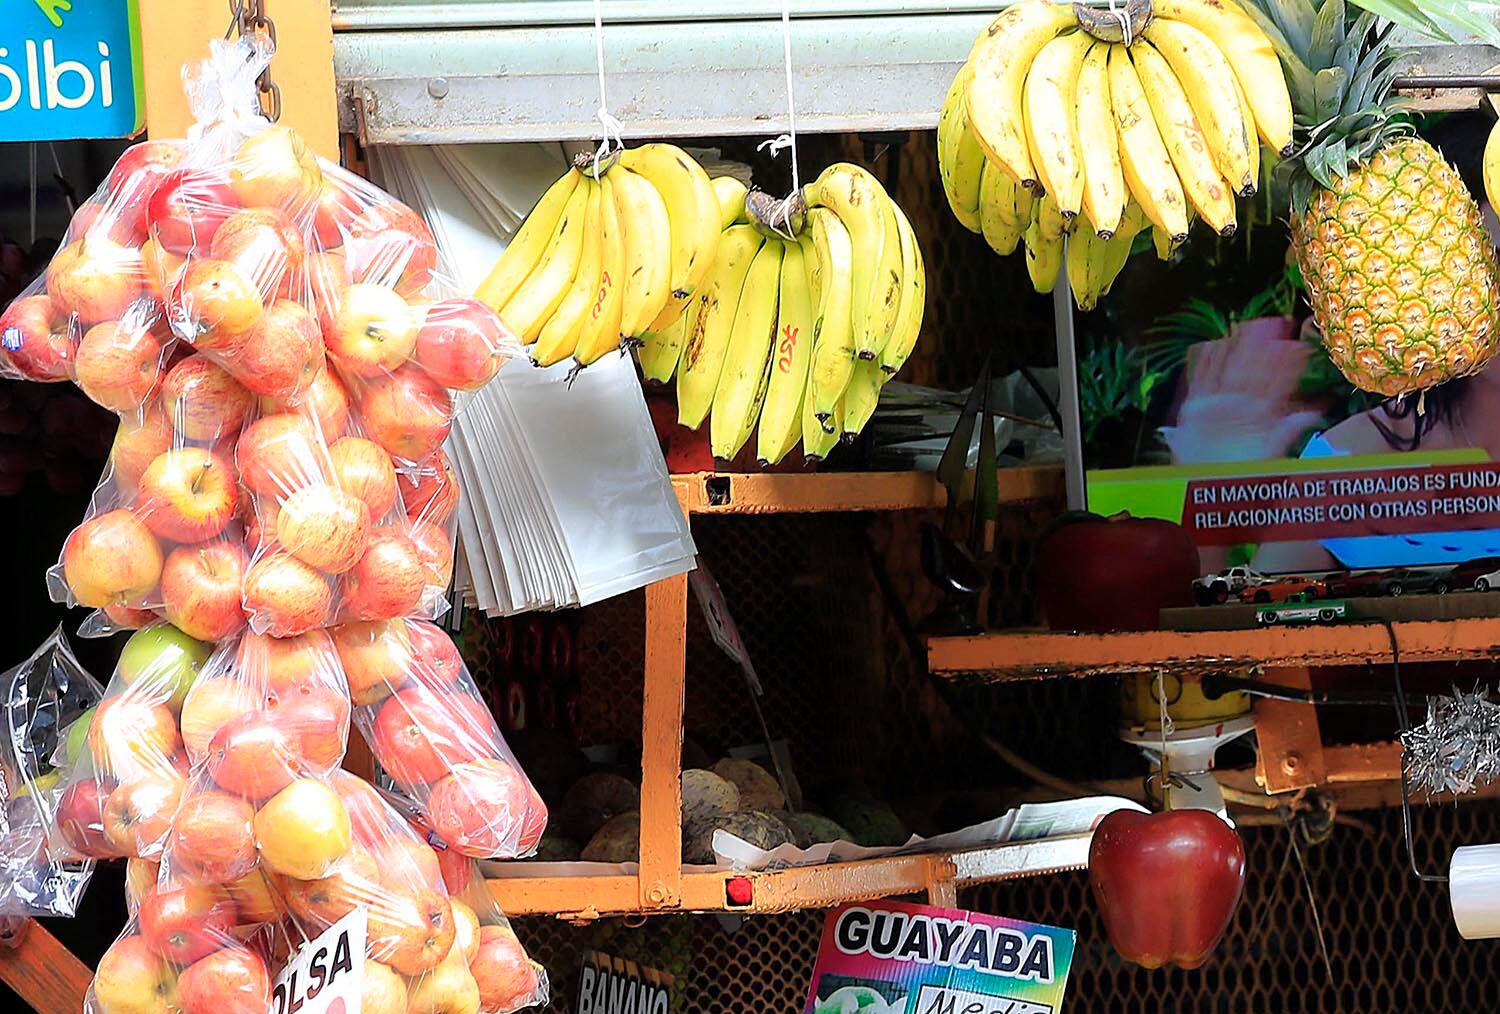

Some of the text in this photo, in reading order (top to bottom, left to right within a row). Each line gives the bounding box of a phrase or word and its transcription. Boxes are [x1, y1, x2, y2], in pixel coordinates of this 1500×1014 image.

[1193, 487, 1217, 504] EN
[1220, 479, 1300, 503] MAYORÍA
[1303, 479, 1327, 497] DE
[1329, 473, 1420, 497] TRABAJOS
[1424, 472, 1446, 491] ES
[1195, 505, 1325, 529] RELACIONARSE
[1328, 502, 1365, 521] CON
[1369, 499, 1428, 518] OTRAS
[837, 911, 1051, 980] GUAYABA
